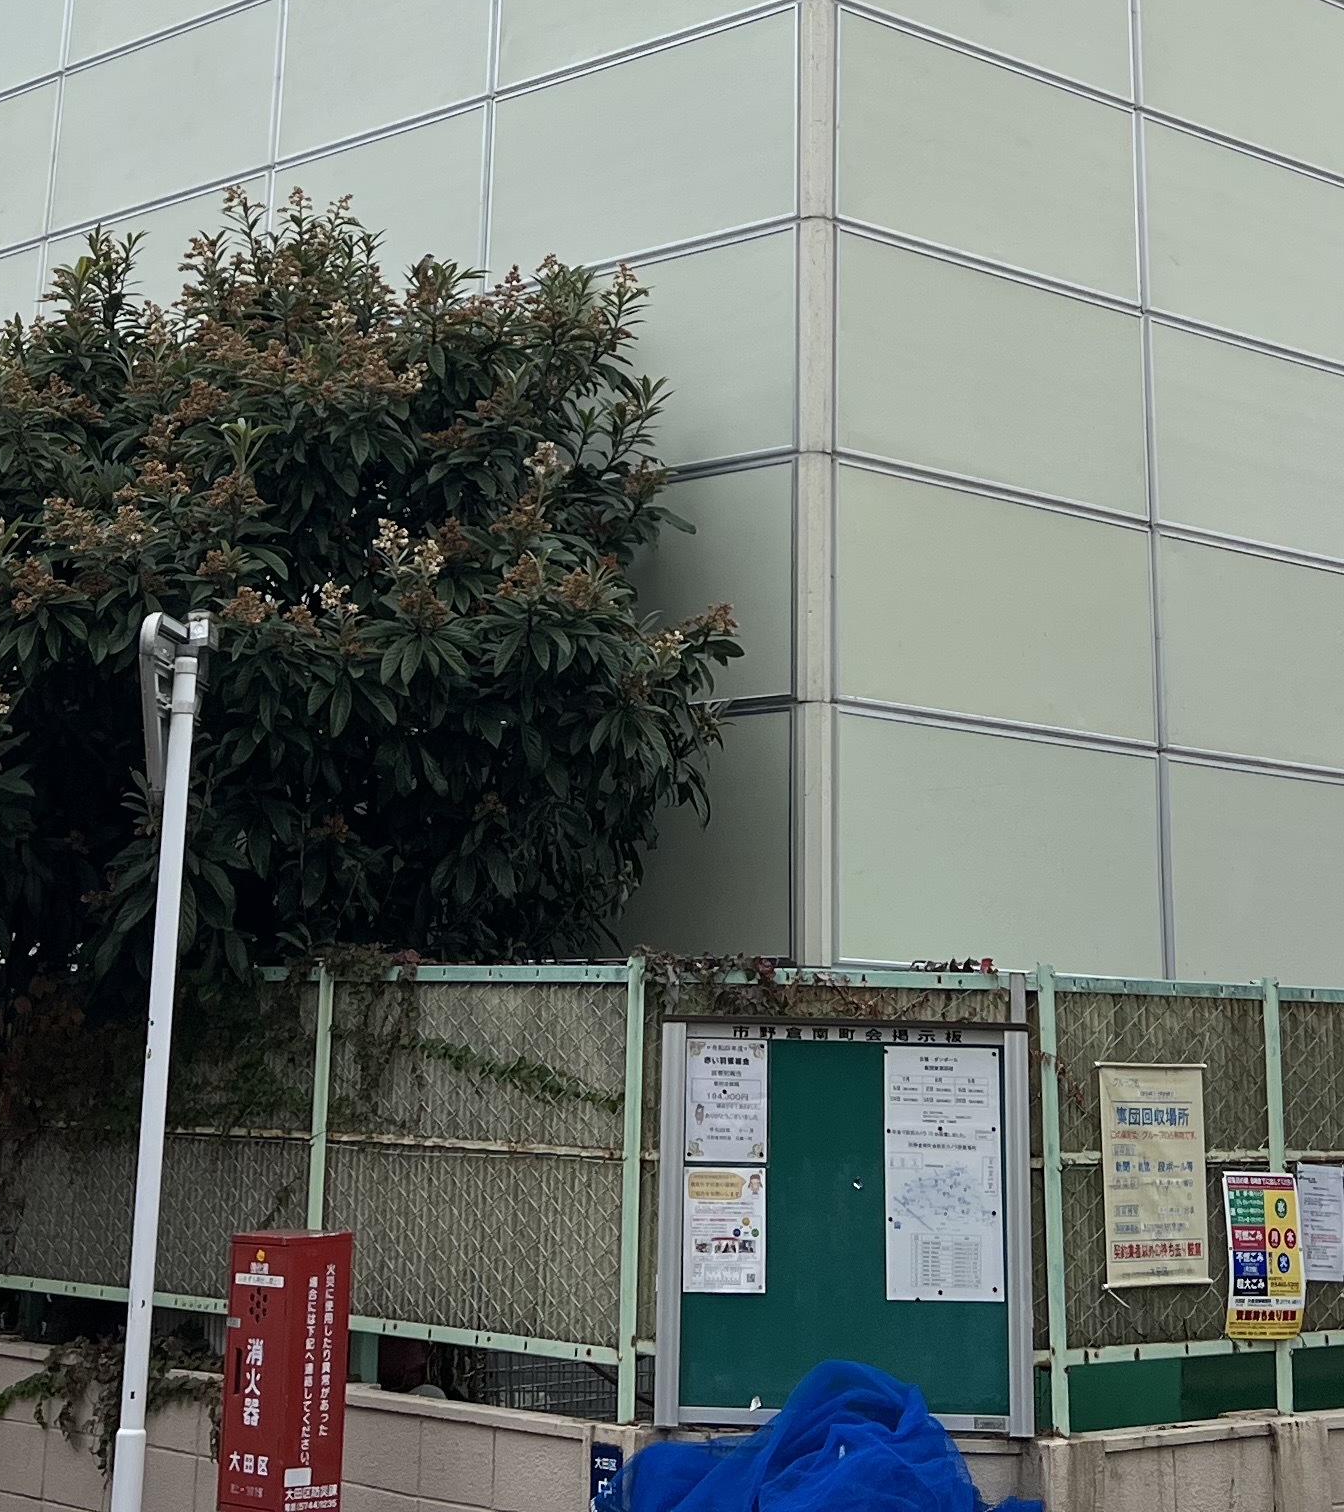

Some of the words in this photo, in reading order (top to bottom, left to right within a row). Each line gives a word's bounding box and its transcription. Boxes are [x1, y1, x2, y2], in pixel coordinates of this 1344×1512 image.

[732, 1025, 963, 1043] 市野倉南町会掲示板
[1116, 1106, 1190, 1126] 集団回収場所
[1234, 1229, 1264, 1241] 可燃ごみ
[1236, 1251, 1264, 1262] 不燃ごみ
[243, 1338, 264, 1427] 消火器
[228, 1450, 269, 1476] 大田区
[594, 1457, 617, 1471] 大田区
